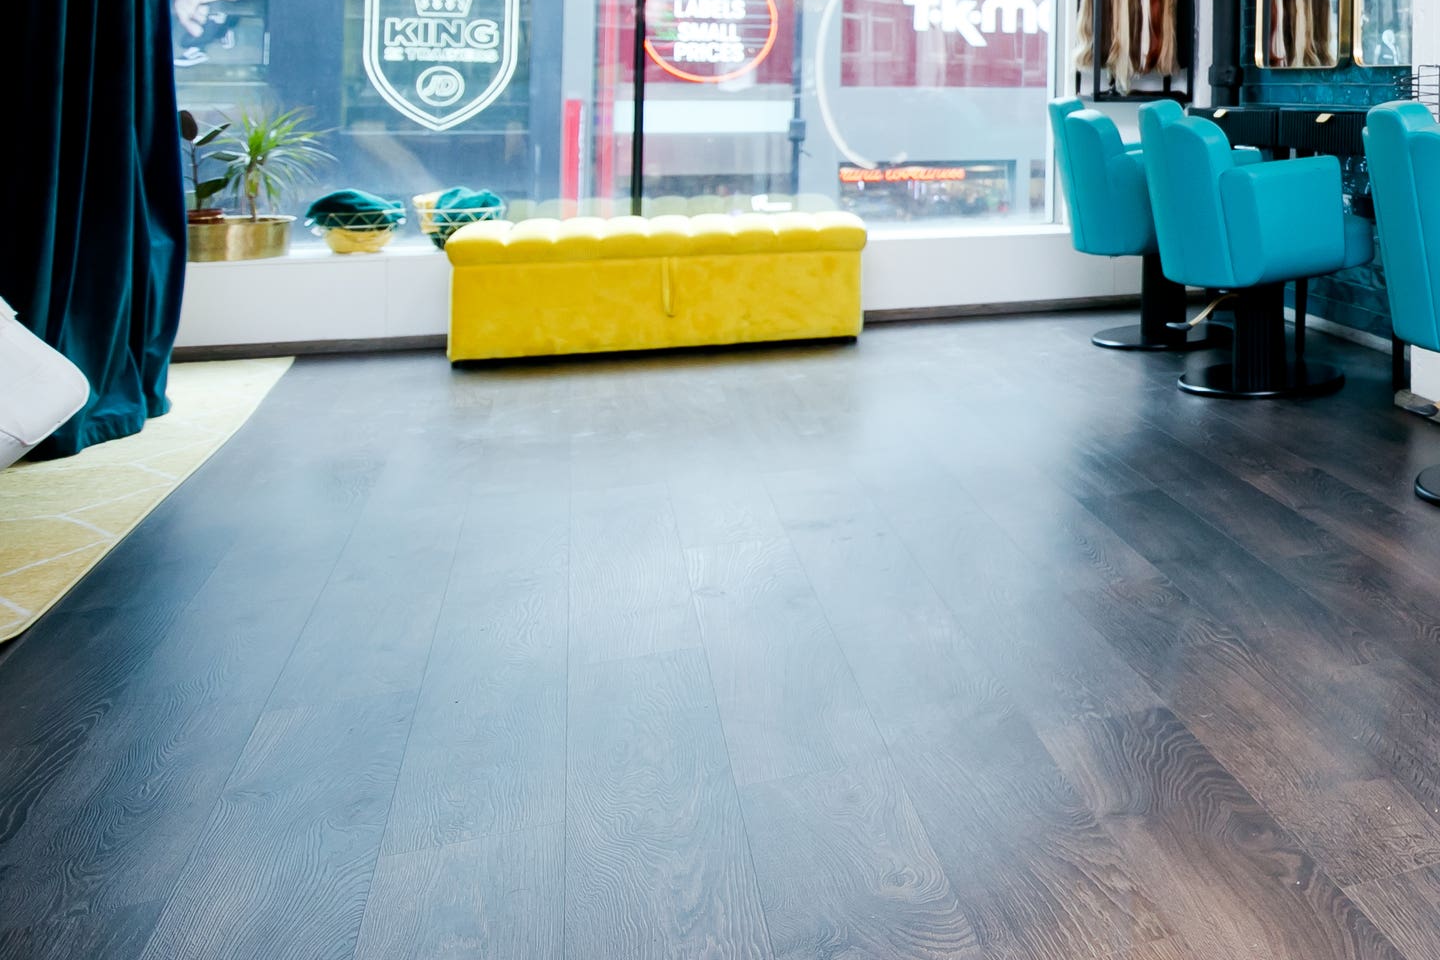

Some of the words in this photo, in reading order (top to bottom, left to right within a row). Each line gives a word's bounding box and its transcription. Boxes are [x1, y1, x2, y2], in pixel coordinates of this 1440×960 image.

[383, 17, 500, 50] KING
[677, 21, 742, 42] SMALL
[673, 41, 745, 63] PRICES
